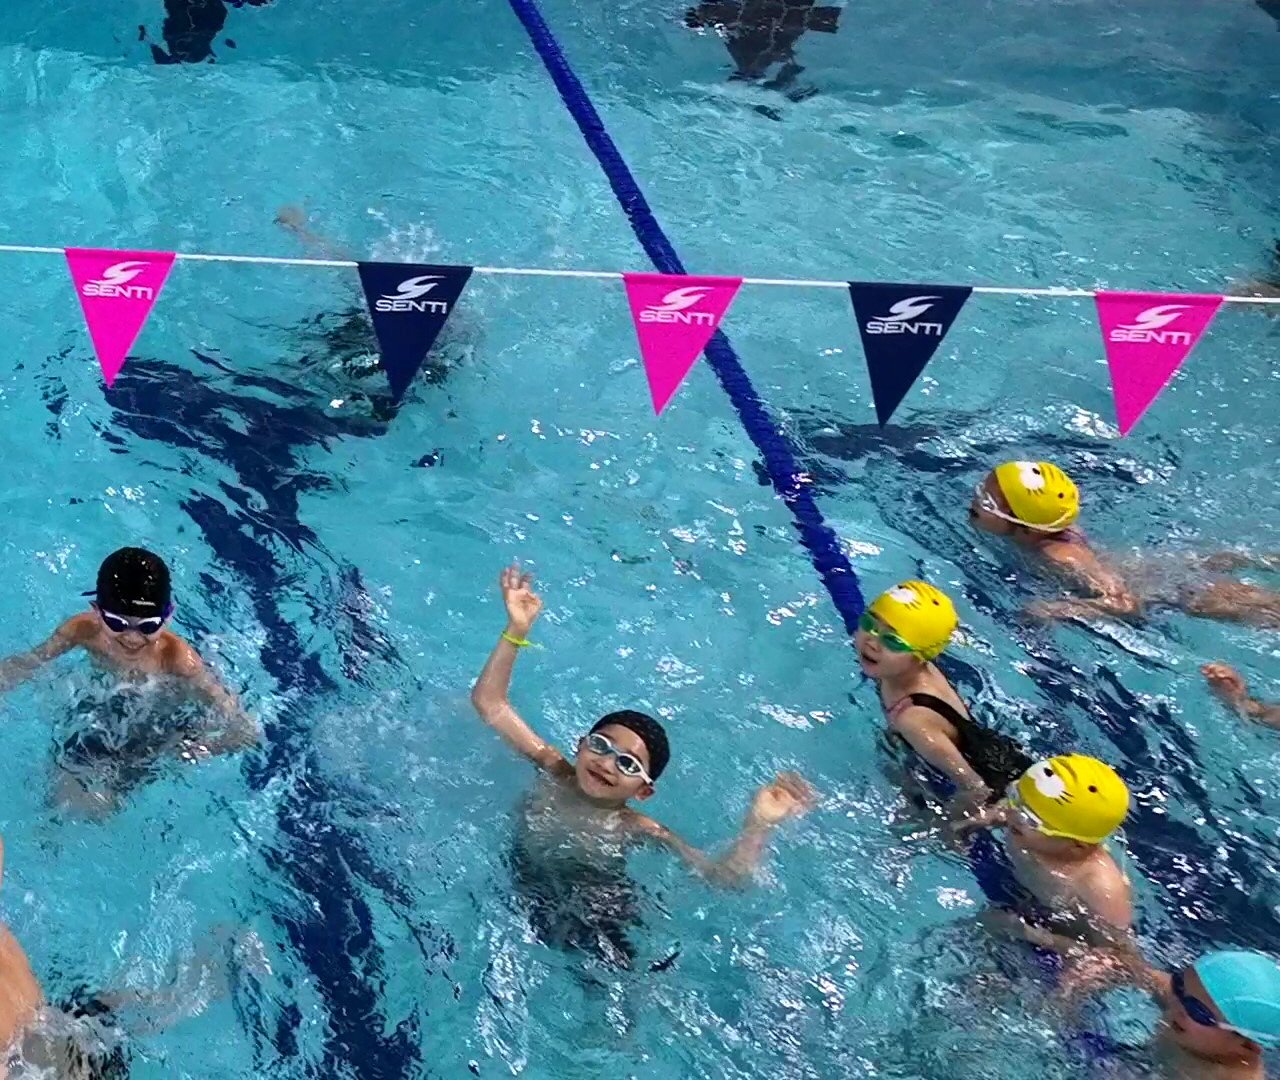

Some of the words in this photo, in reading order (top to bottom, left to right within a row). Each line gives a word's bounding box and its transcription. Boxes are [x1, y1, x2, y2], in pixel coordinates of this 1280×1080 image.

[82, 283, 153, 300] SENTI
[374, 299, 448, 315] SENTI
[638, 309, 715, 327] SENTI
[865, 321, 943, 336] SENTI
[1109, 328, 1192, 346] SENTI
